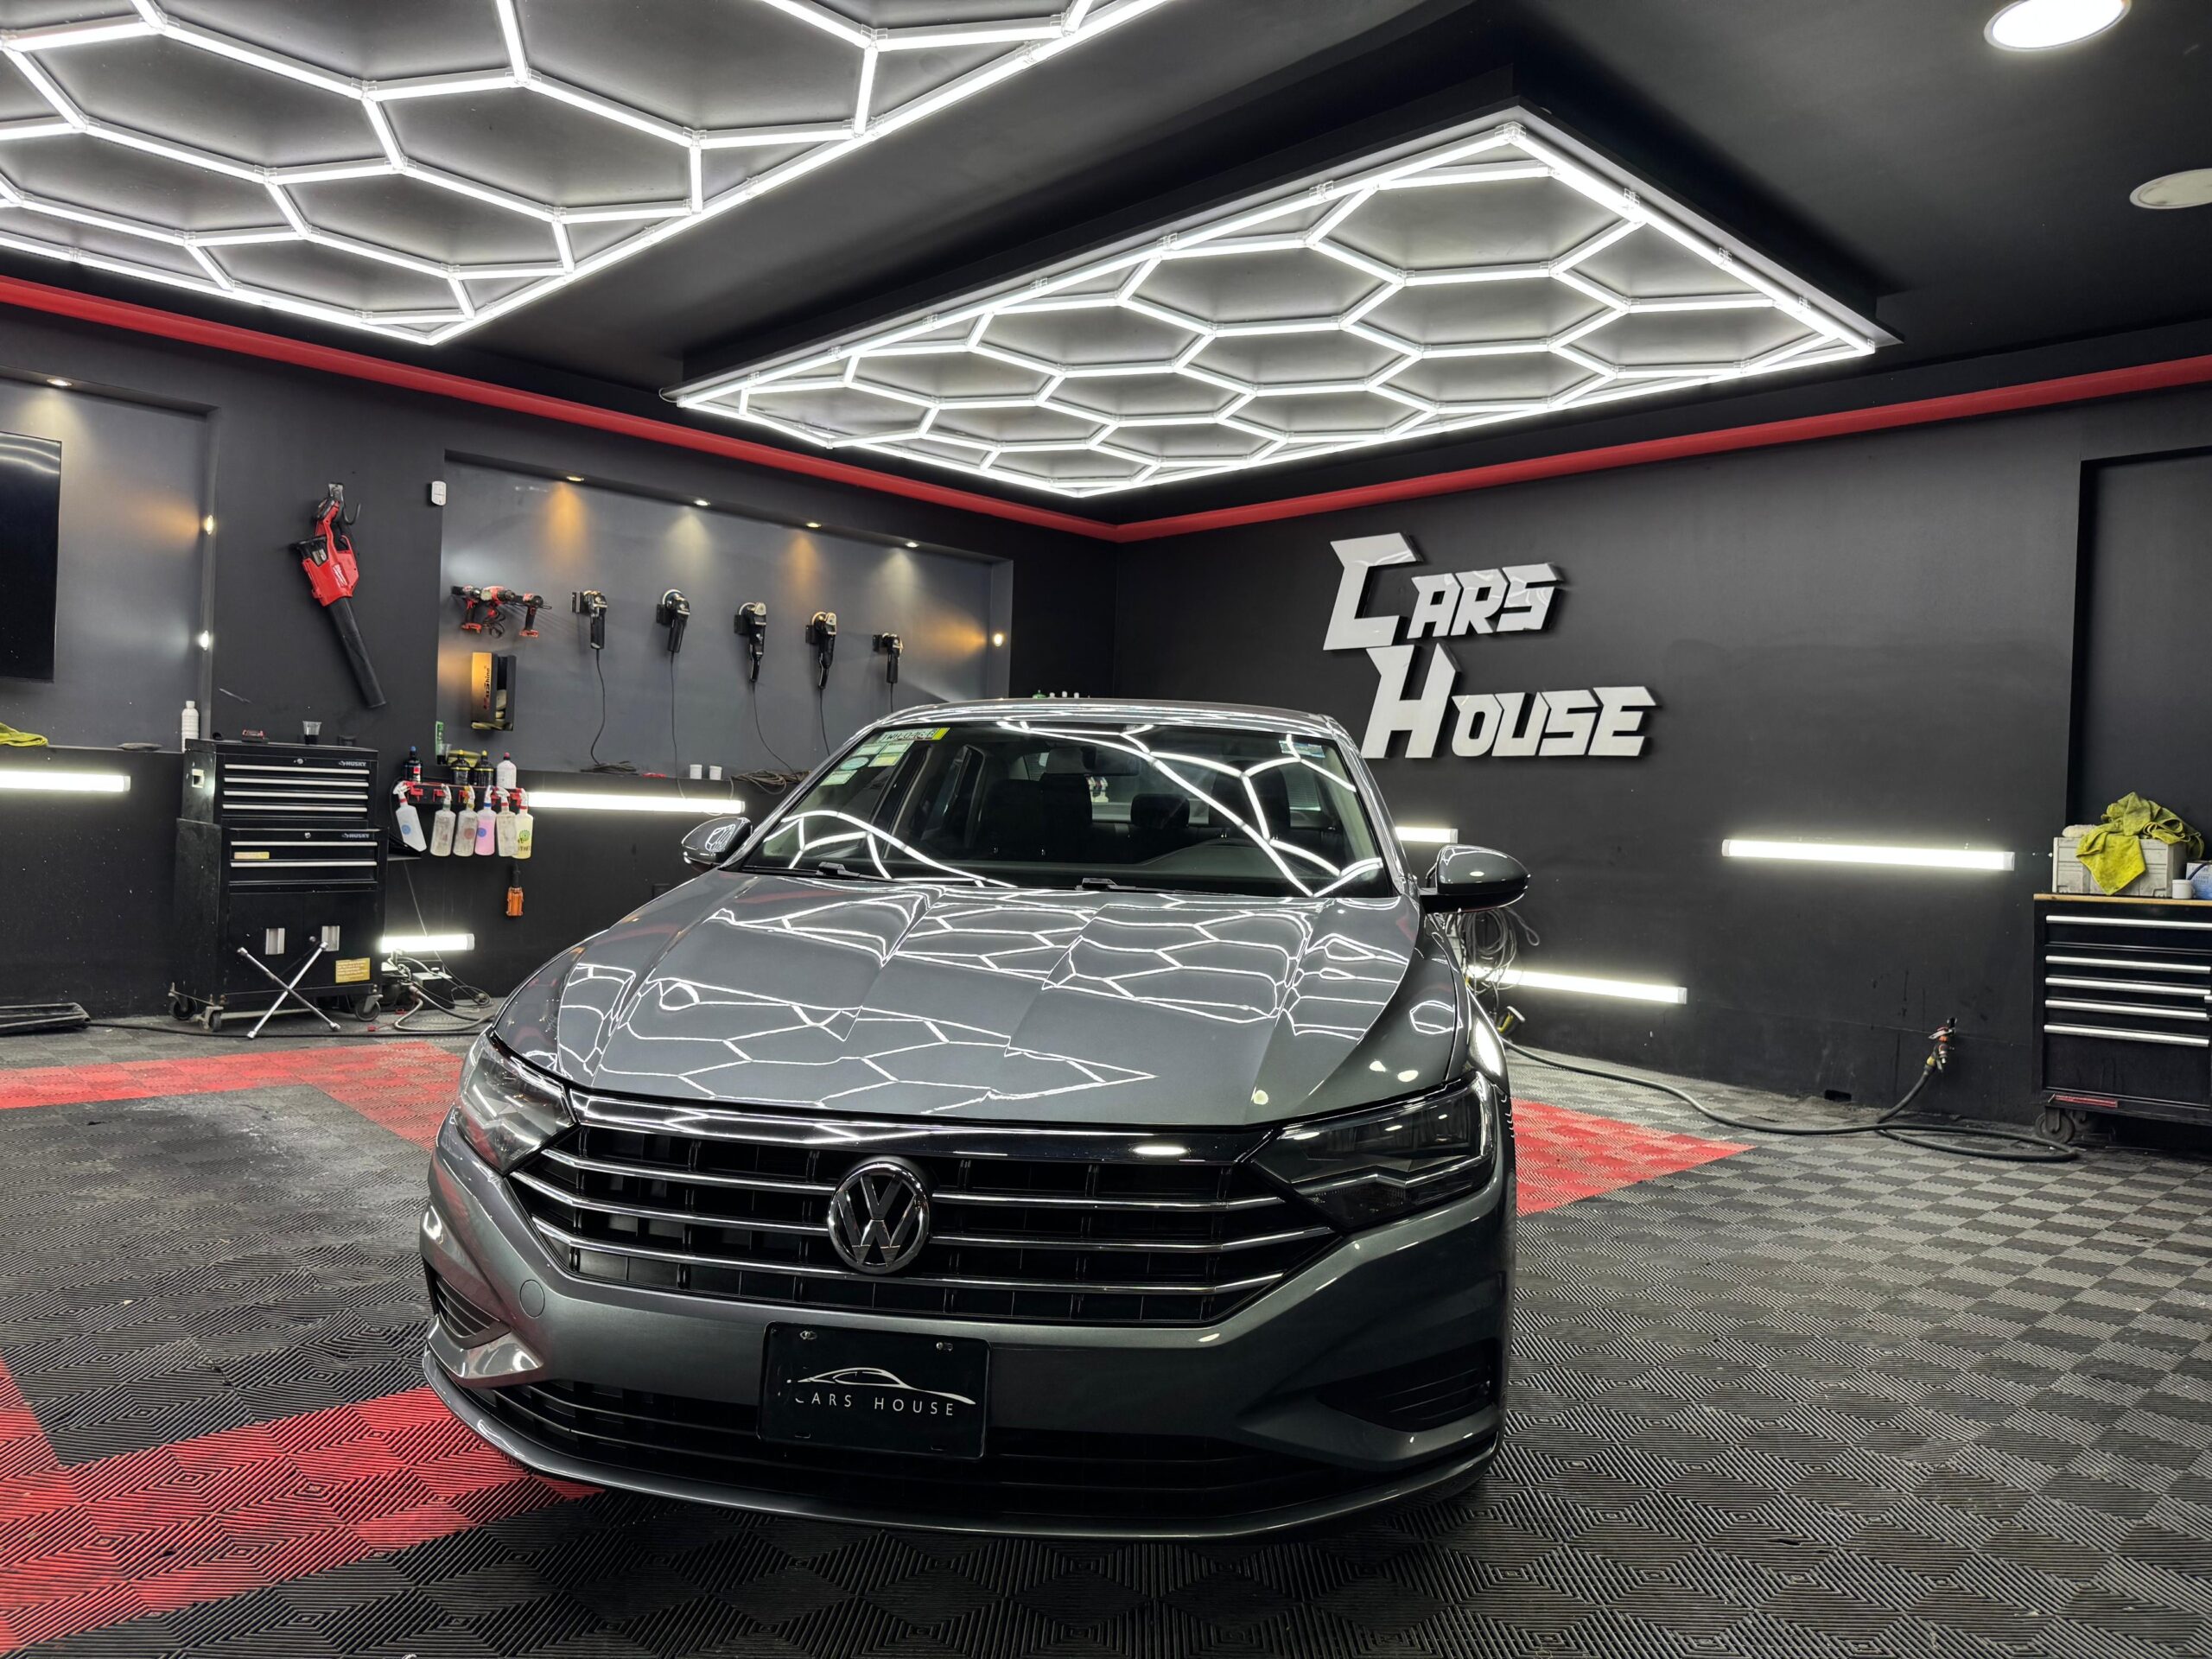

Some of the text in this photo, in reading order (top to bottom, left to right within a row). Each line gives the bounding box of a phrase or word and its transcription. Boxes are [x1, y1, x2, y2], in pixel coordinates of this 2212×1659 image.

[1323, 532, 1562, 650] CARS
[1361, 643, 1659, 760] HOUSE
[874, 1397, 954, 1416] HOUSE
